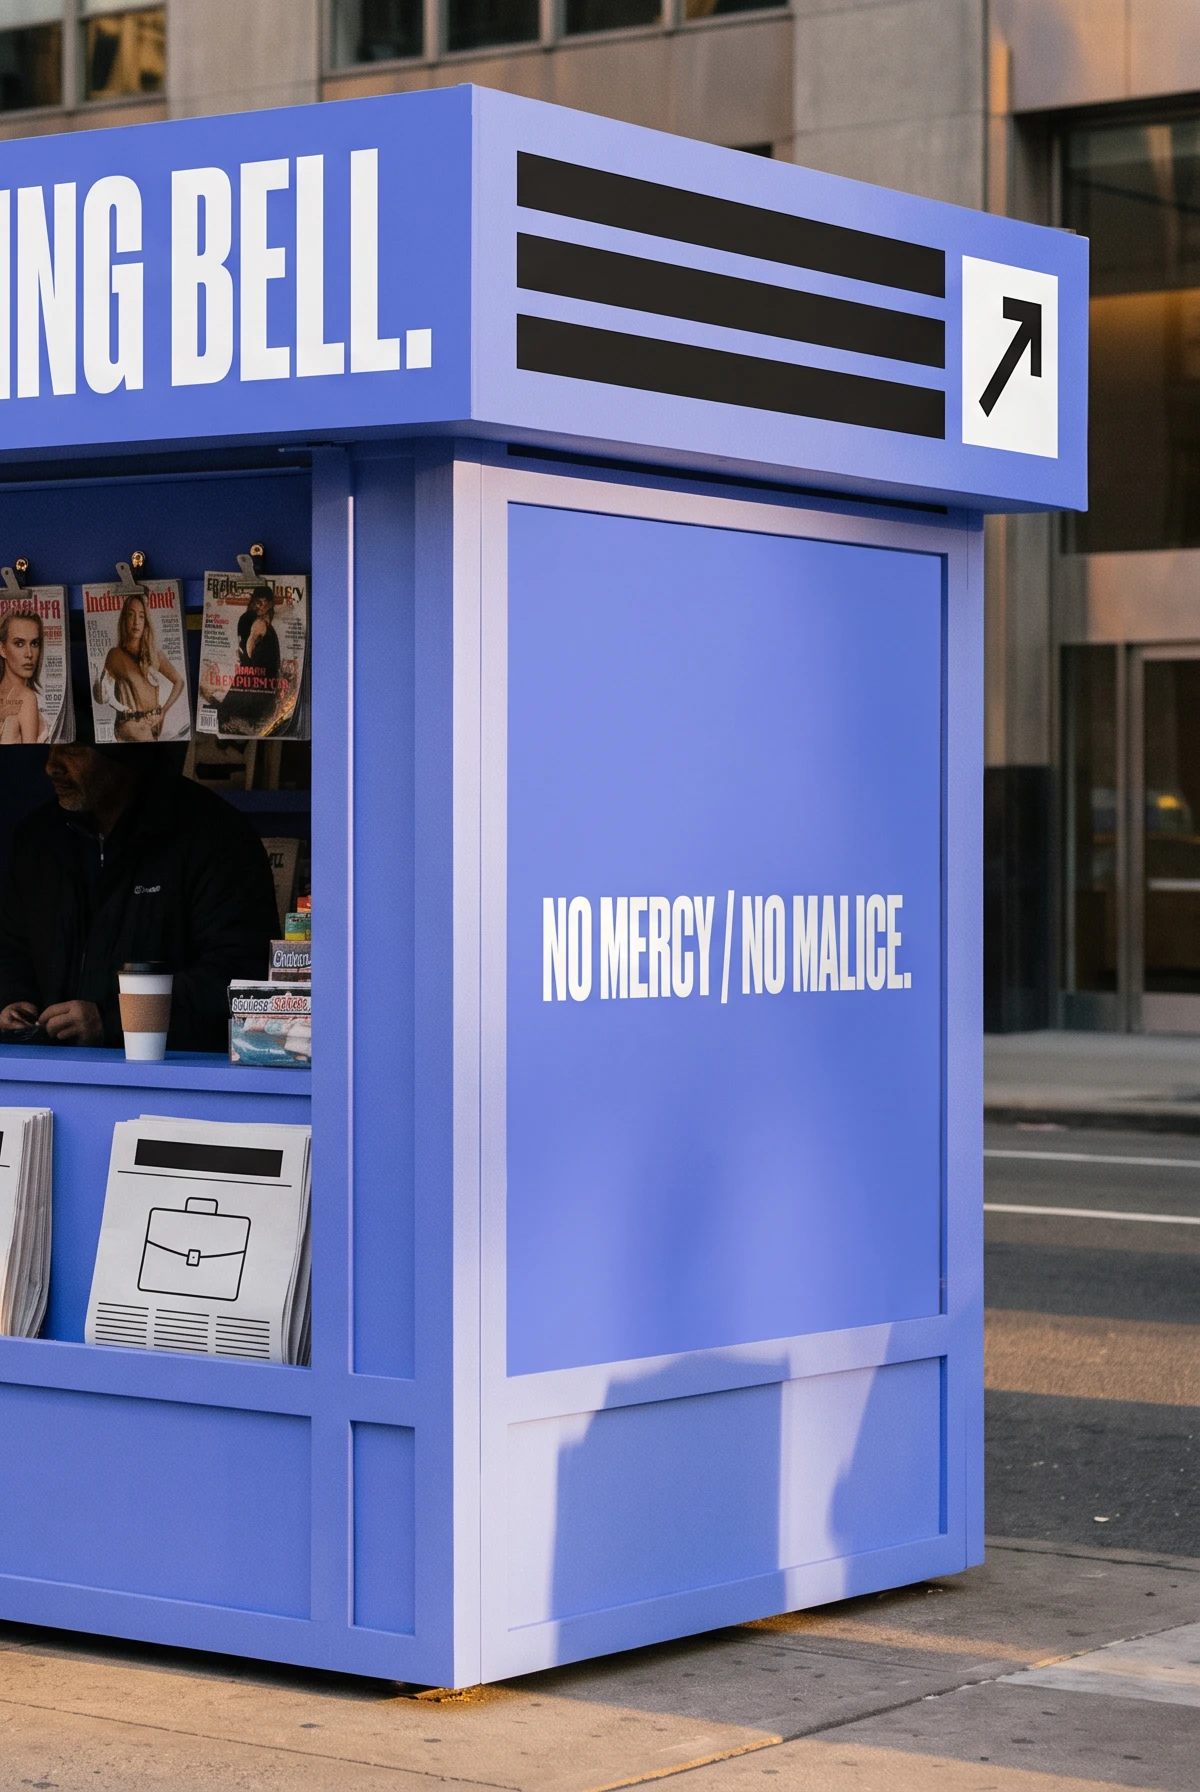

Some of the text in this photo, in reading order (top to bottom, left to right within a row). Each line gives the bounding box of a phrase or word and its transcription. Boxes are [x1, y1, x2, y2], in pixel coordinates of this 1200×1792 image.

[171, 148, 432, 387] BELL.
[542, 889, 912, 1004] NO MERCY / NO MALICE.
